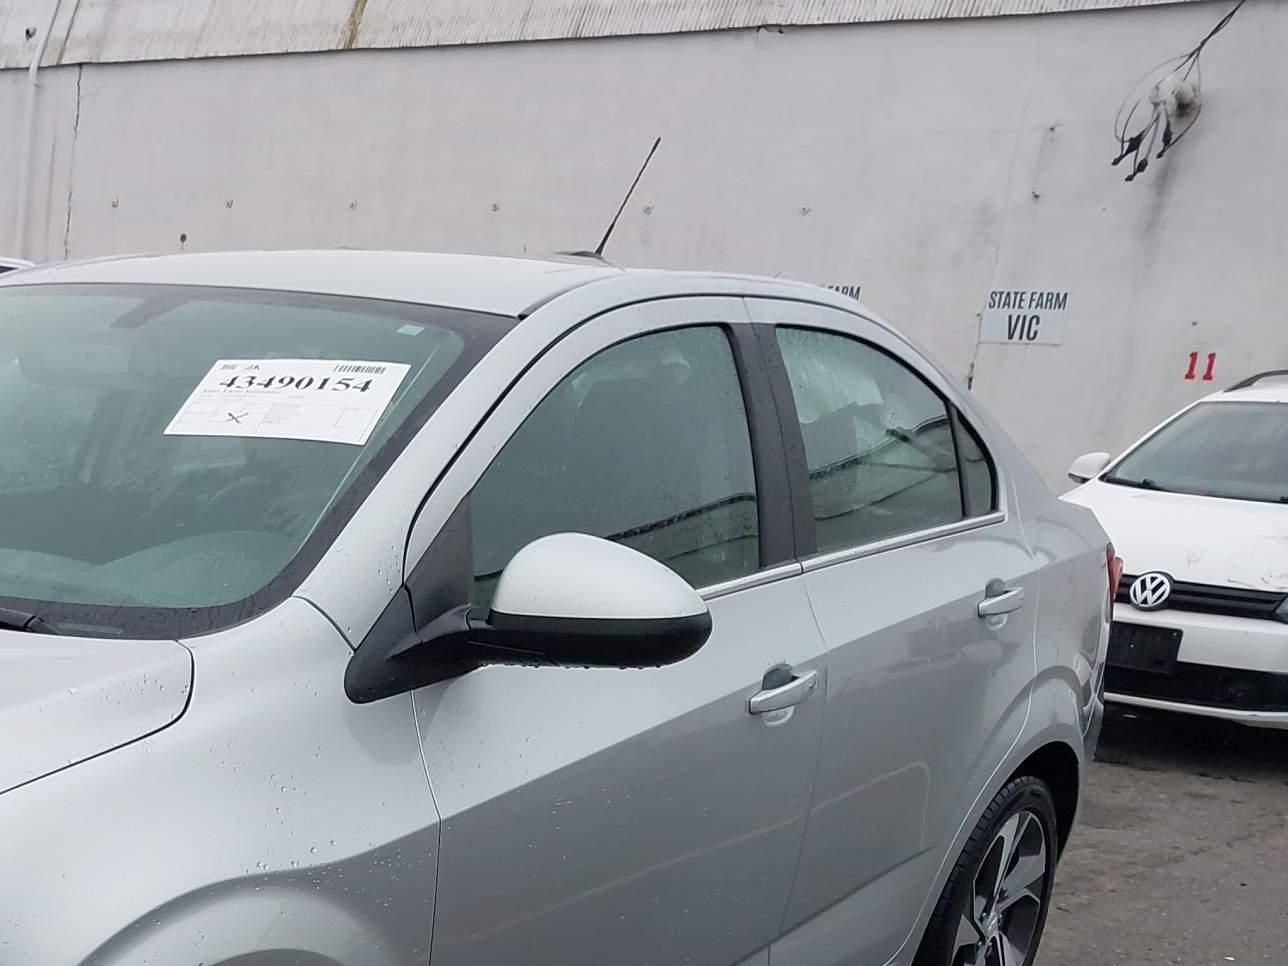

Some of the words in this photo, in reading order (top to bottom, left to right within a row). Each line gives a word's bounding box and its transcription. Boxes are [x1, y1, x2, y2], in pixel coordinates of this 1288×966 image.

[988, 290, 1027, 309] STATE
[1028, 291, 1069, 311] FARM
[1007, 314, 1041, 341] VIC
[1184, 352, 1216, 381] 11
[218, 375, 373, 392] 43490154
